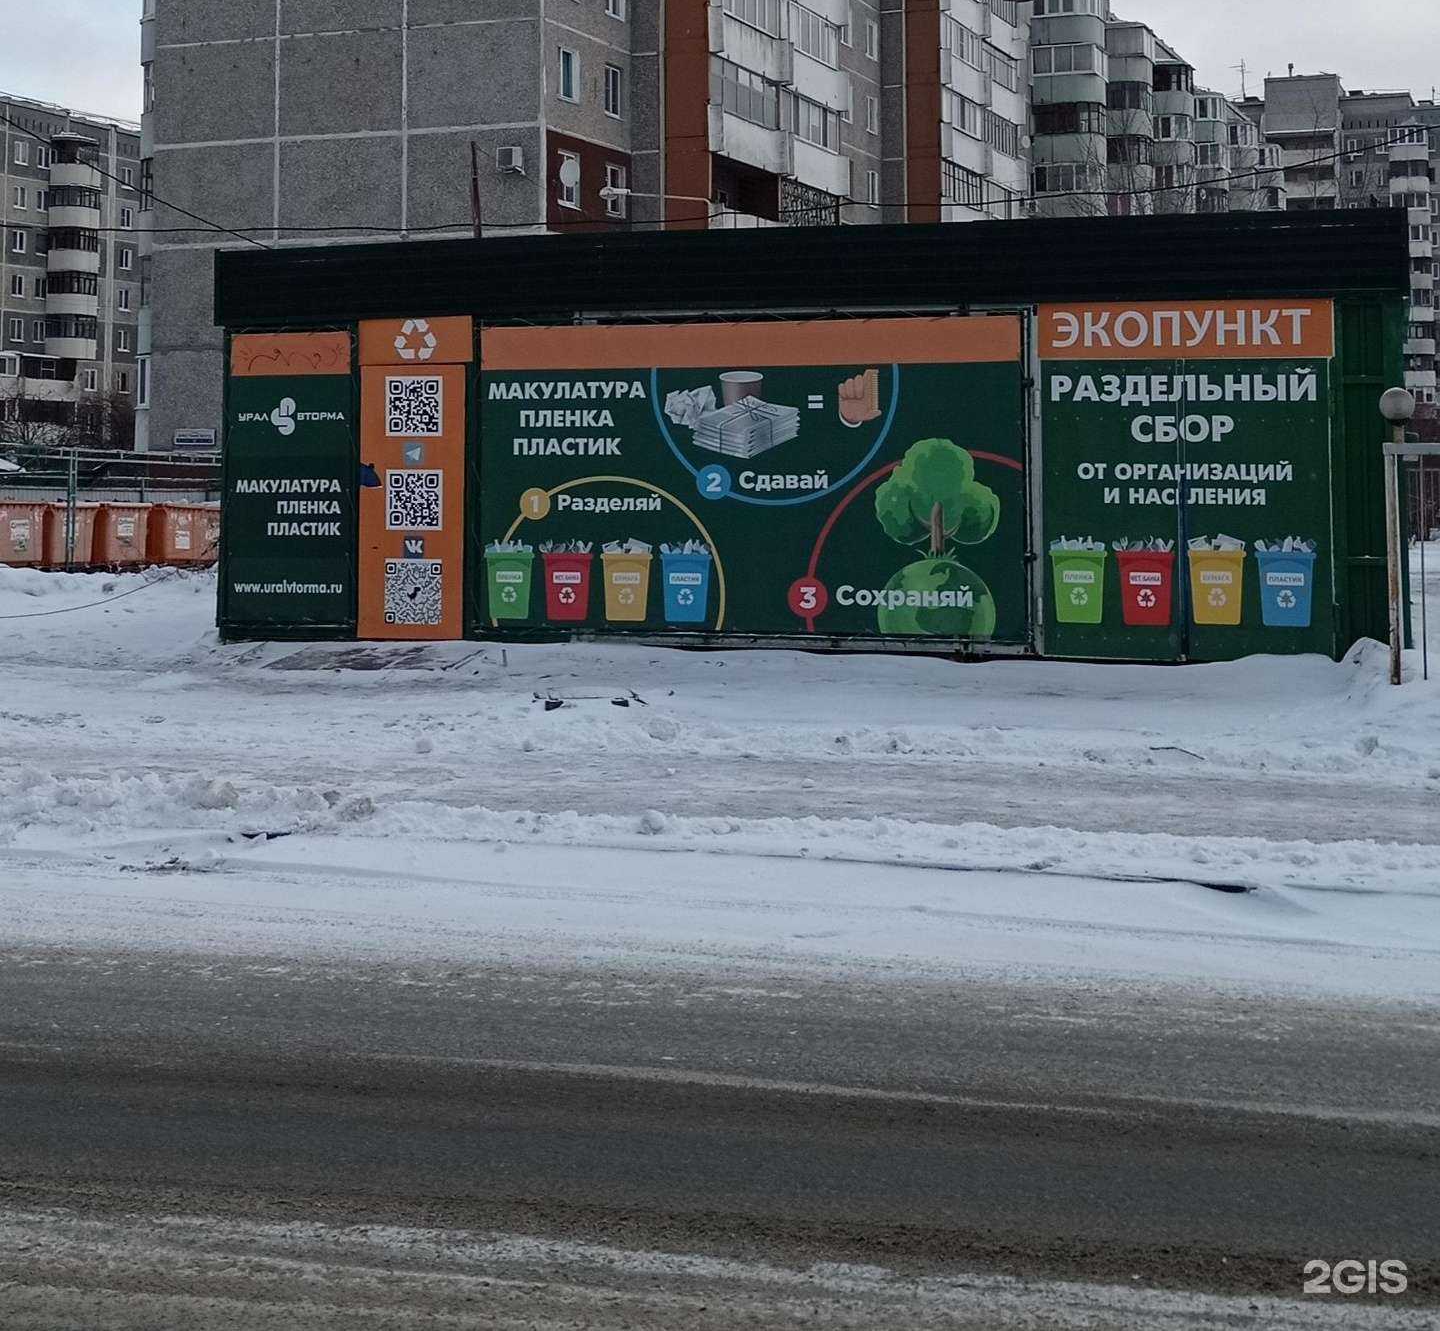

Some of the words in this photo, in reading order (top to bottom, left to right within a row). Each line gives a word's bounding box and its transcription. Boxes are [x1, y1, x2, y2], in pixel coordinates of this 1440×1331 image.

[1051, 308, 1312, 349] ЭКОПУНКТ
[488, 381, 646, 400] МАКУЛАТУРА
[1050, 368, 1318, 406] РАЗДЕЛЬНЫЙ
[238, 412, 269, 422] УРАЛ
[297, 411, 345, 421] ВТОРМА
[519, 410, 614, 428] ПЛЕНКА
[1131, 415, 1235, 442] СБОР
[512, 438, 622, 456] ПЛАСТИК
[1077, 463, 1107, 481] ОТ
[1114, 460, 1293, 483] ОРГАНИЗАЦИЙ
[236, 479, 342, 494] МАКУЛАТУРА
[706, 473, 722, 491] 2
[739, 471, 829, 492] Сдавай
[530, 495, 540, 512] 1
[557, 494, 662, 513] Разделяй
[1104, 488, 1120, 505] И
[276, 501, 341, 515] ПЛЕНКА
[267, 522, 341, 537] ПЛАСТИК
[234, 580, 342, 594] www.uralvtorma.ru
[799, 587, 816, 609] 3
[836, 585, 973, 607] Сохраняй
